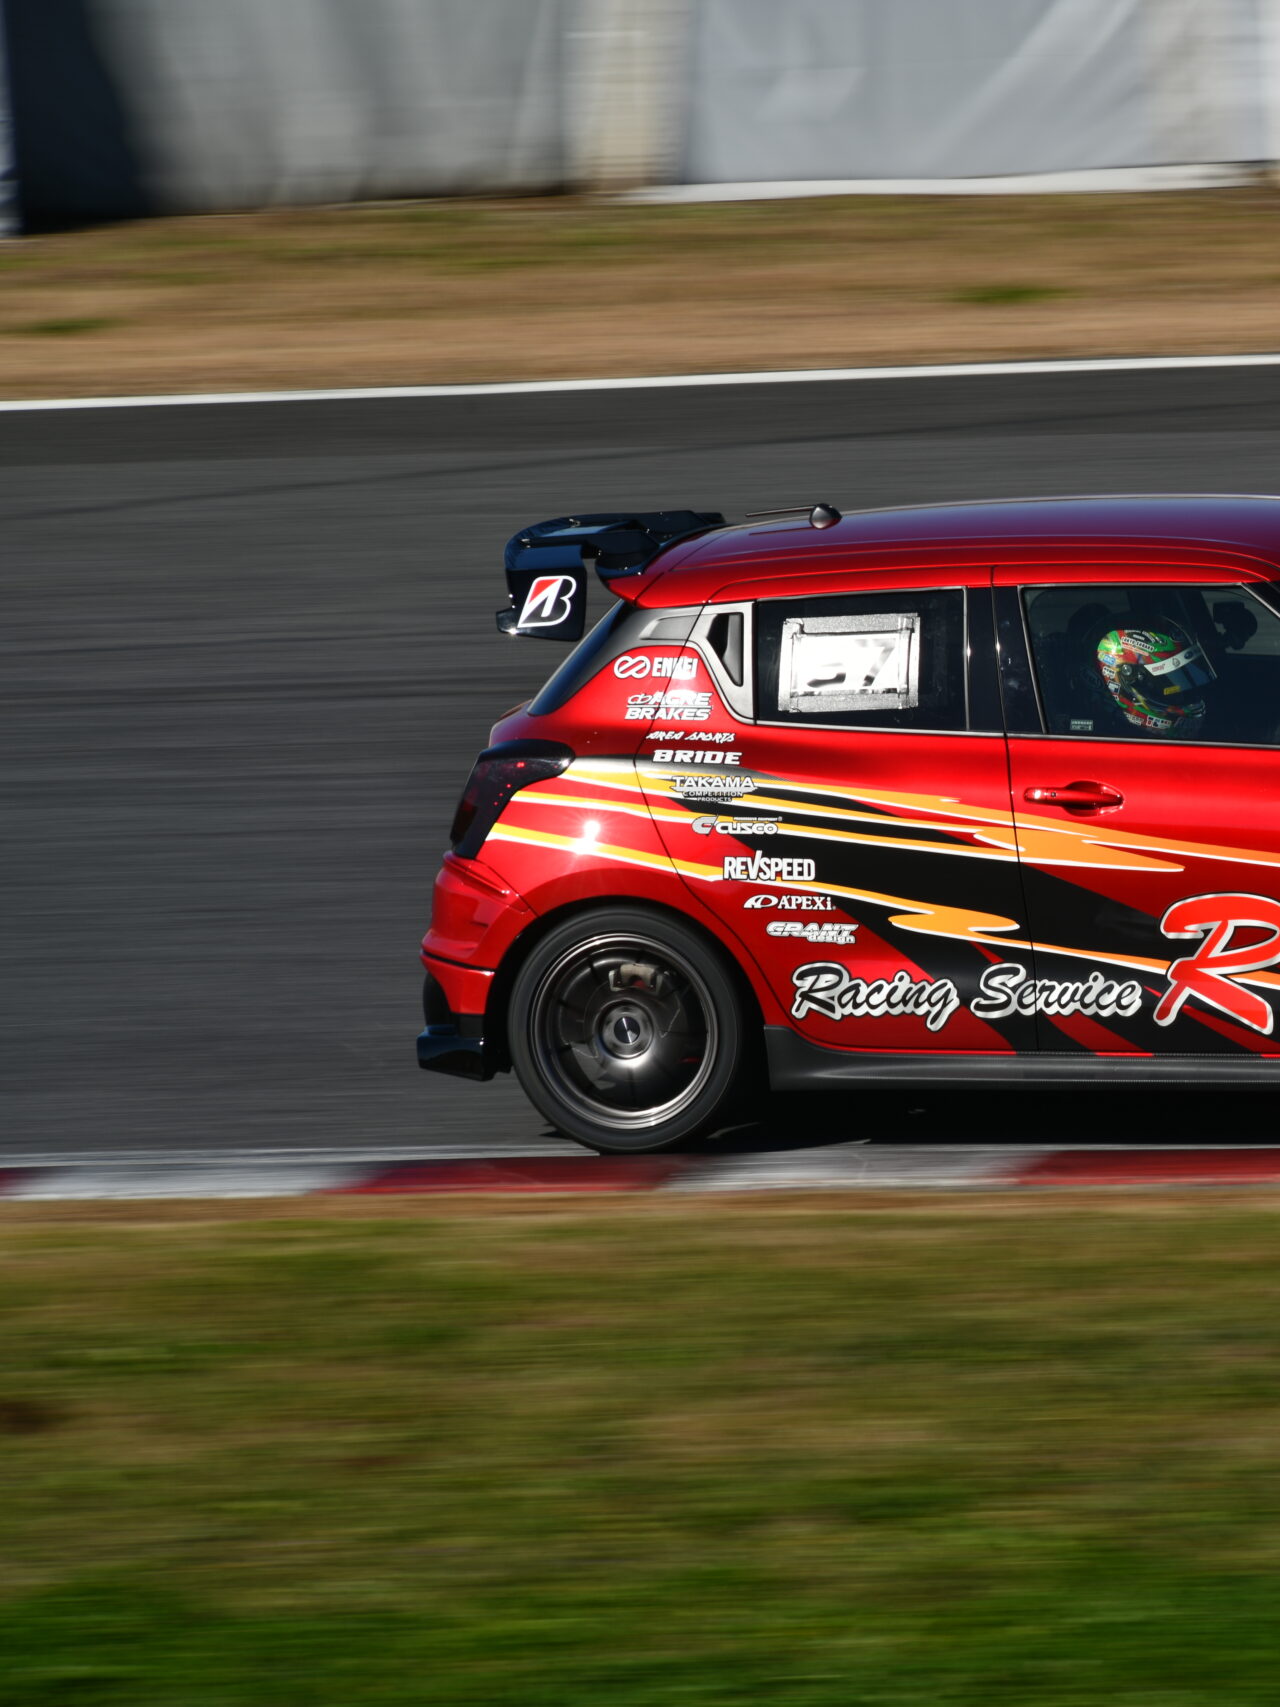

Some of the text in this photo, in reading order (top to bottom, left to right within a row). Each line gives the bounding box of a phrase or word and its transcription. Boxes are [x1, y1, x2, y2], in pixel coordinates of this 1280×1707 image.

[624, 707, 711, 721] BRAKES
[646, 731, 735, 744] AREA SPORTS
[652, 750, 742, 765] BRIDE
[672, 776, 755, 788] TAKAMA
[722, 850, 816, 881] REVSPEED
[791, 962, 960, 1032] Racing
[970, 962, 1143, 1019] Service
